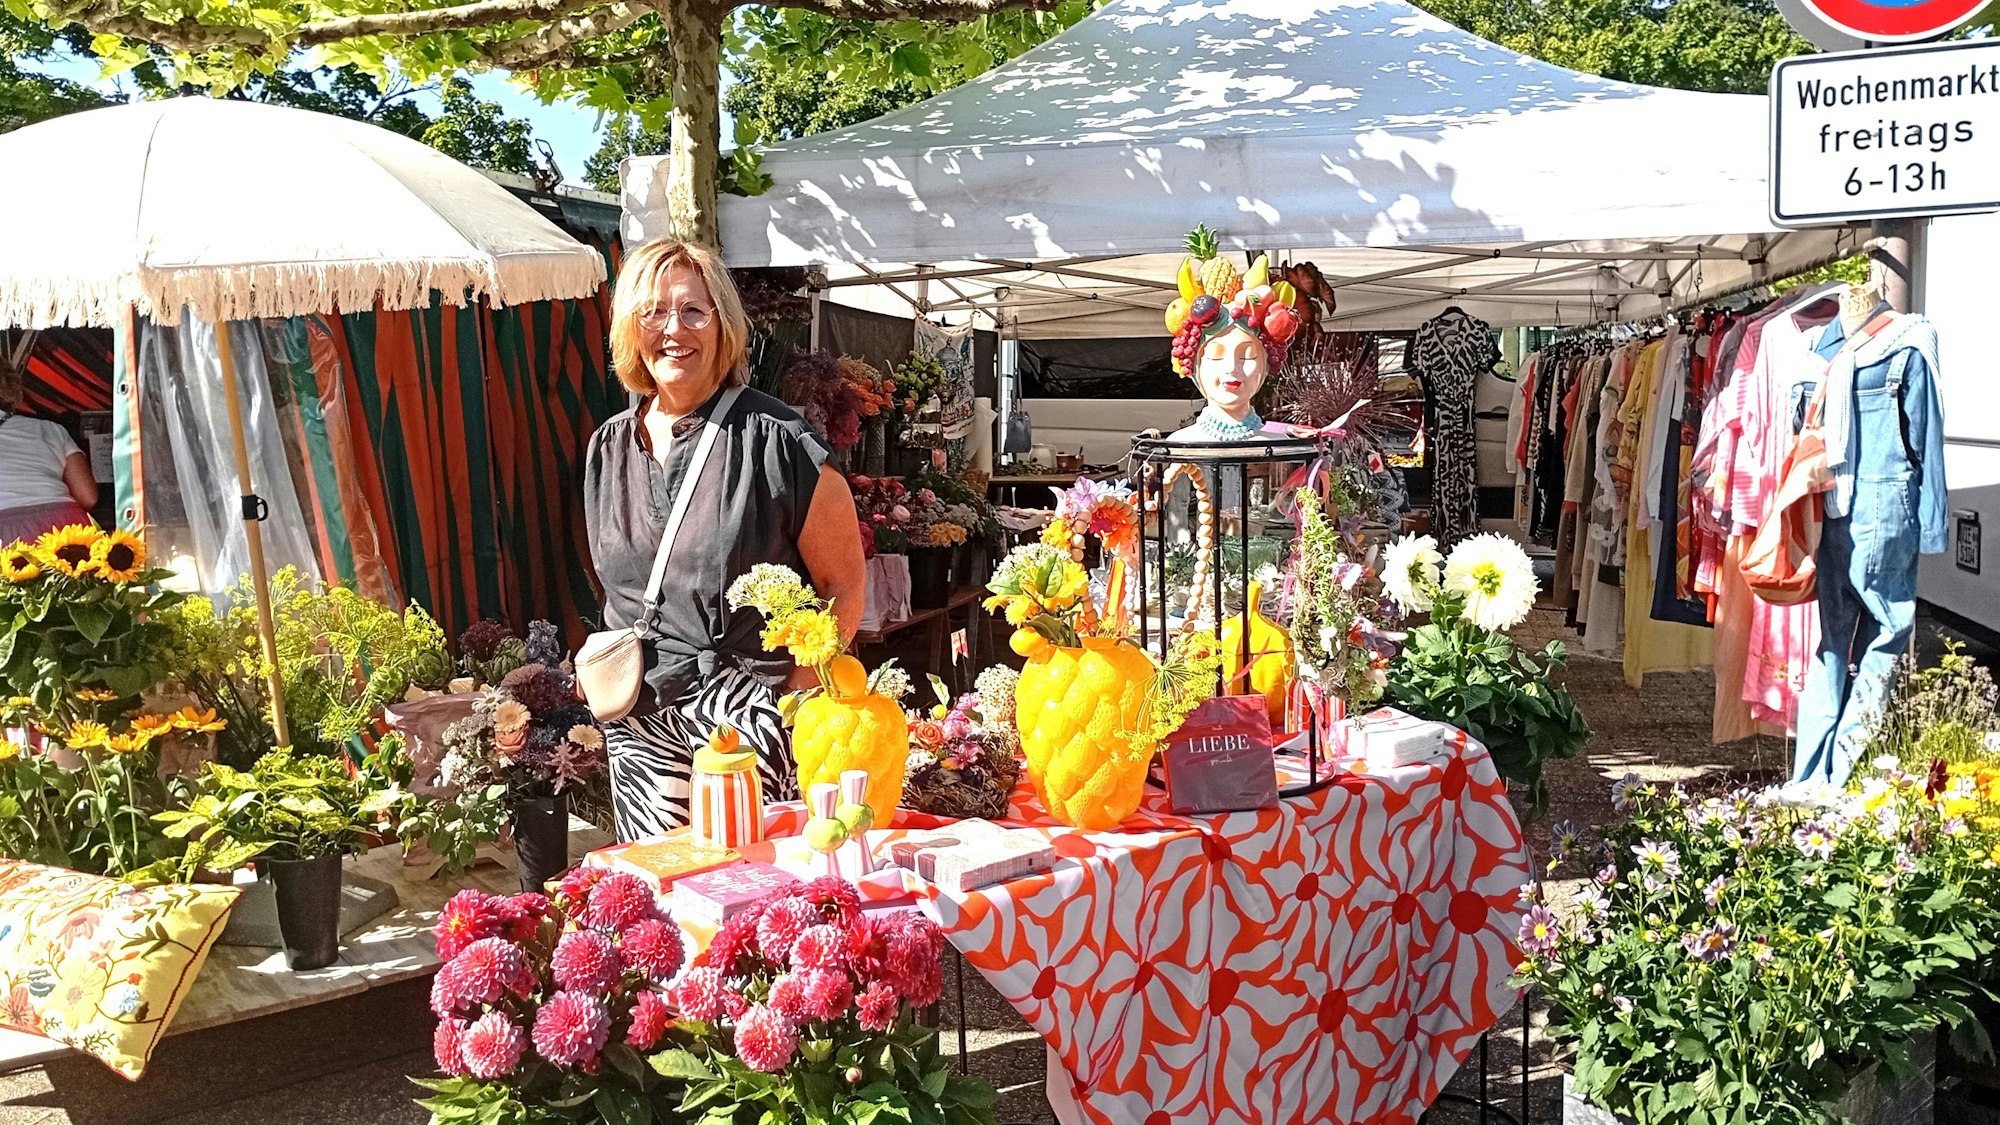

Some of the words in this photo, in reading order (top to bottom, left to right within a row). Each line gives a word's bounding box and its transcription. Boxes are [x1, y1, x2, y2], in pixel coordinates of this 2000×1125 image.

[1797, 64, 1999, 109] Wochenmarkt
[1819, 119, 1974, 152] freitags
[1844, 161, 1946, 196] 6-13h
[1189, 734, 1250, 753] LIEBE
